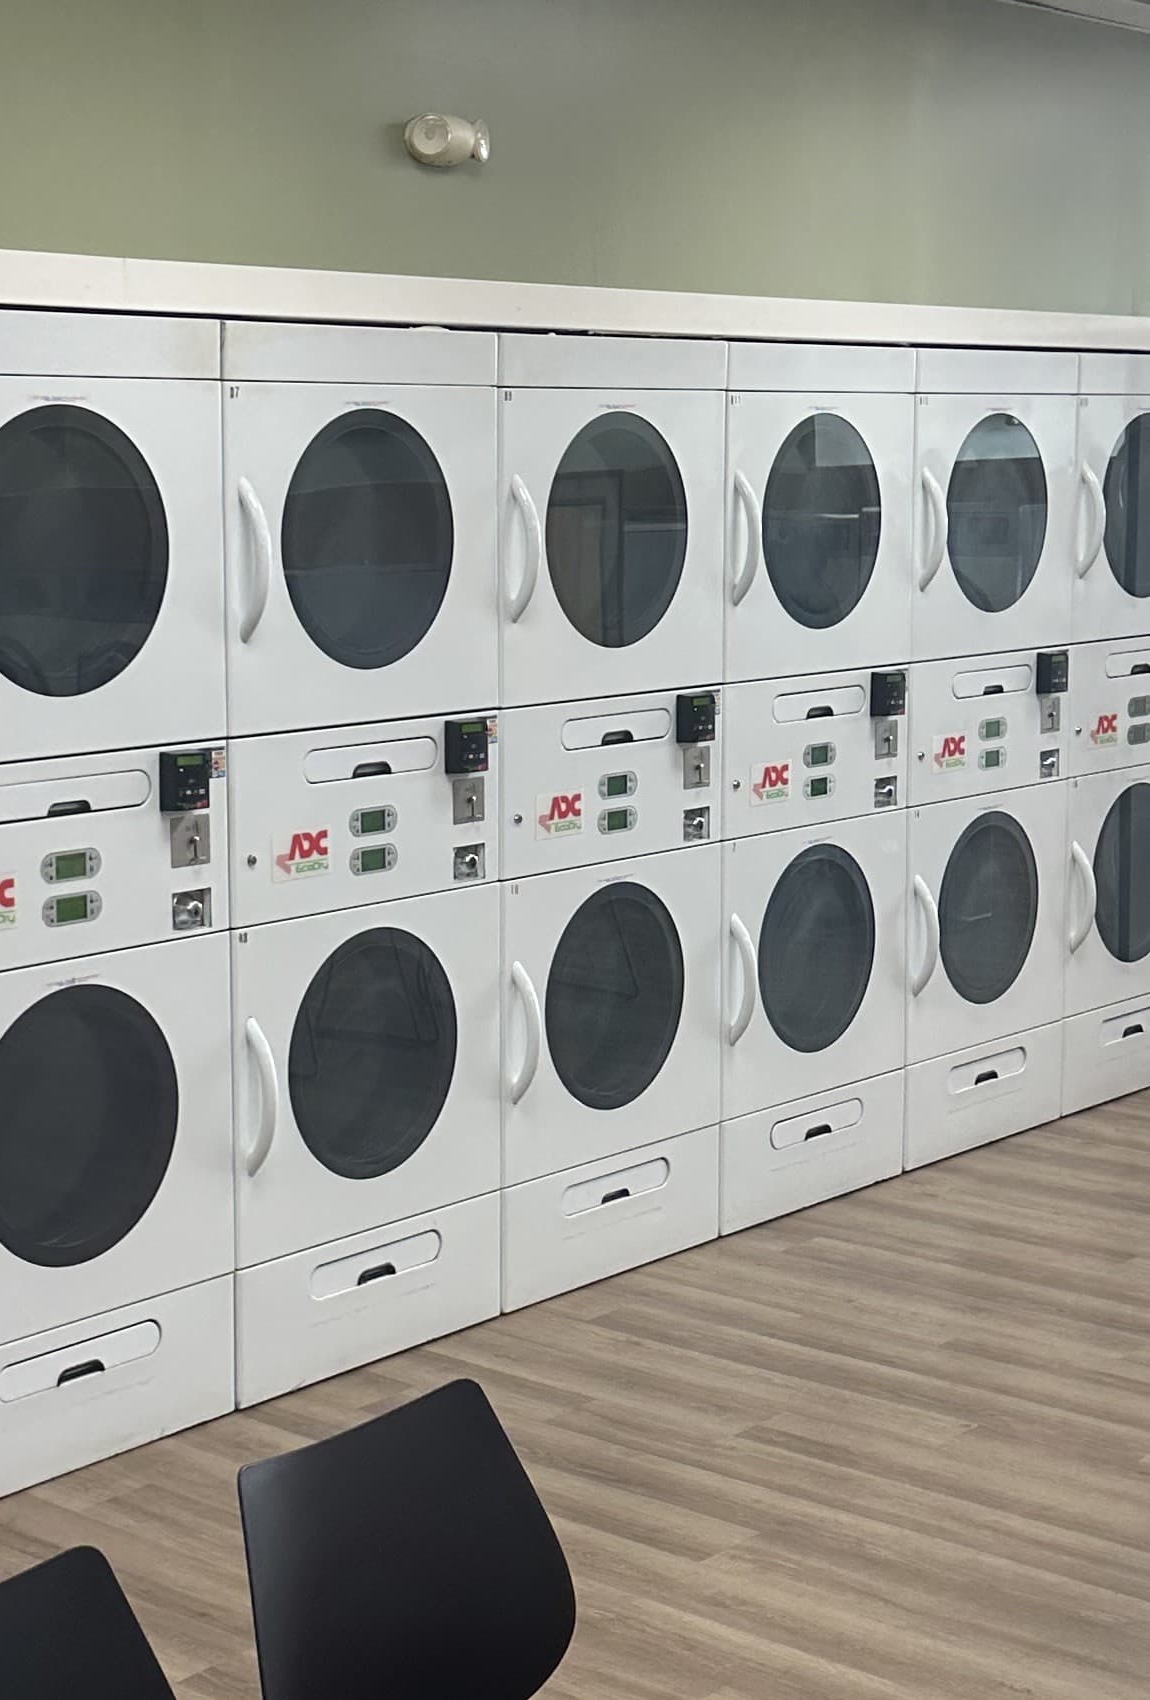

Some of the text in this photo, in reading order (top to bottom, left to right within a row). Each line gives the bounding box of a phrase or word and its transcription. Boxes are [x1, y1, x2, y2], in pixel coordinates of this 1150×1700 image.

[1096, 714, 1117, 735] ADC
[941, 736, 965, 758] ADC
[761, 764, 789, 788] ADC
[549, 794, 582, 821] ADC
[289, 830, 328, 860] ADC
